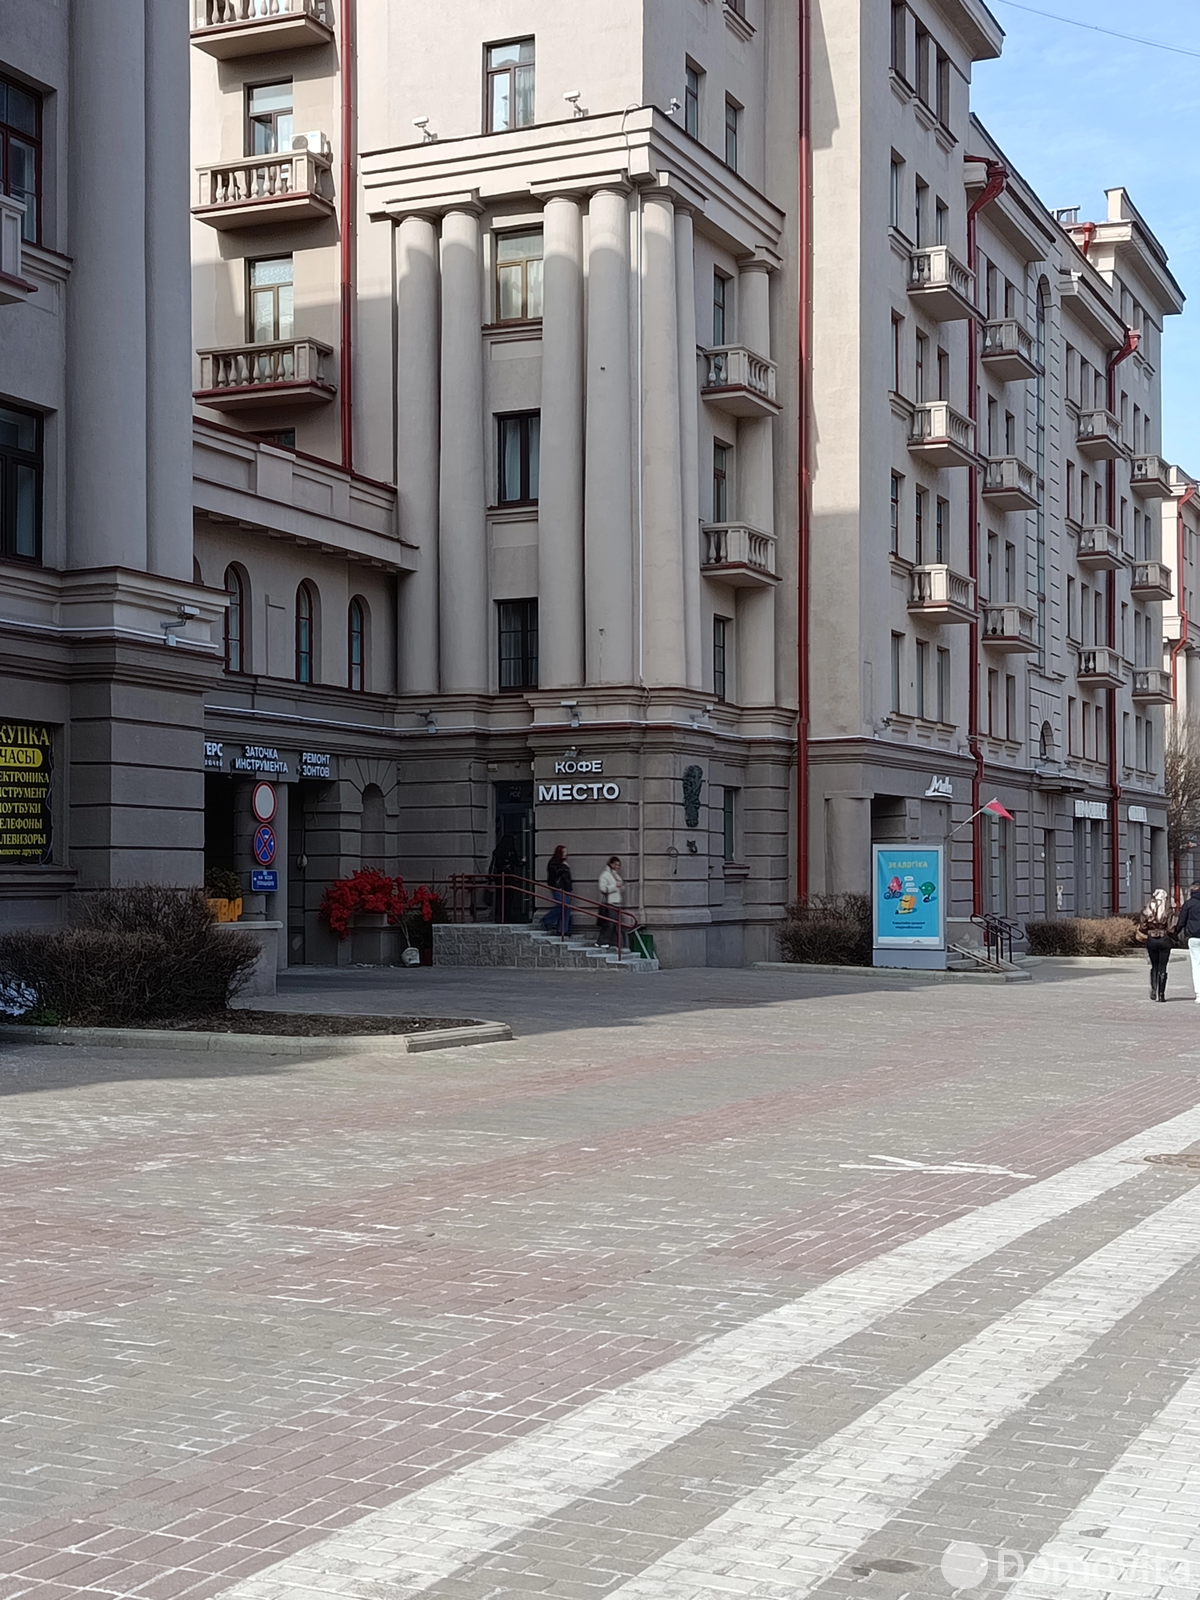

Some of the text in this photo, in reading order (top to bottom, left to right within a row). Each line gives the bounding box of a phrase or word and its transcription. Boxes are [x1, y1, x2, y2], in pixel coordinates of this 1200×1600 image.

[0, 749, 36, 765] ЧАСЫ
[245, 745, 279, 760] ЗАТОЧКА
[302, 752, 331, 765] РЕМОНТ
[235, 757, 289, 774] ИНСТРУМЕНТА
[302, 765, 330, 778] ЗОНТОВ
[555, 760, 603, 774] КОФЕ
[538, 782, 619, 802] МЕСТО
